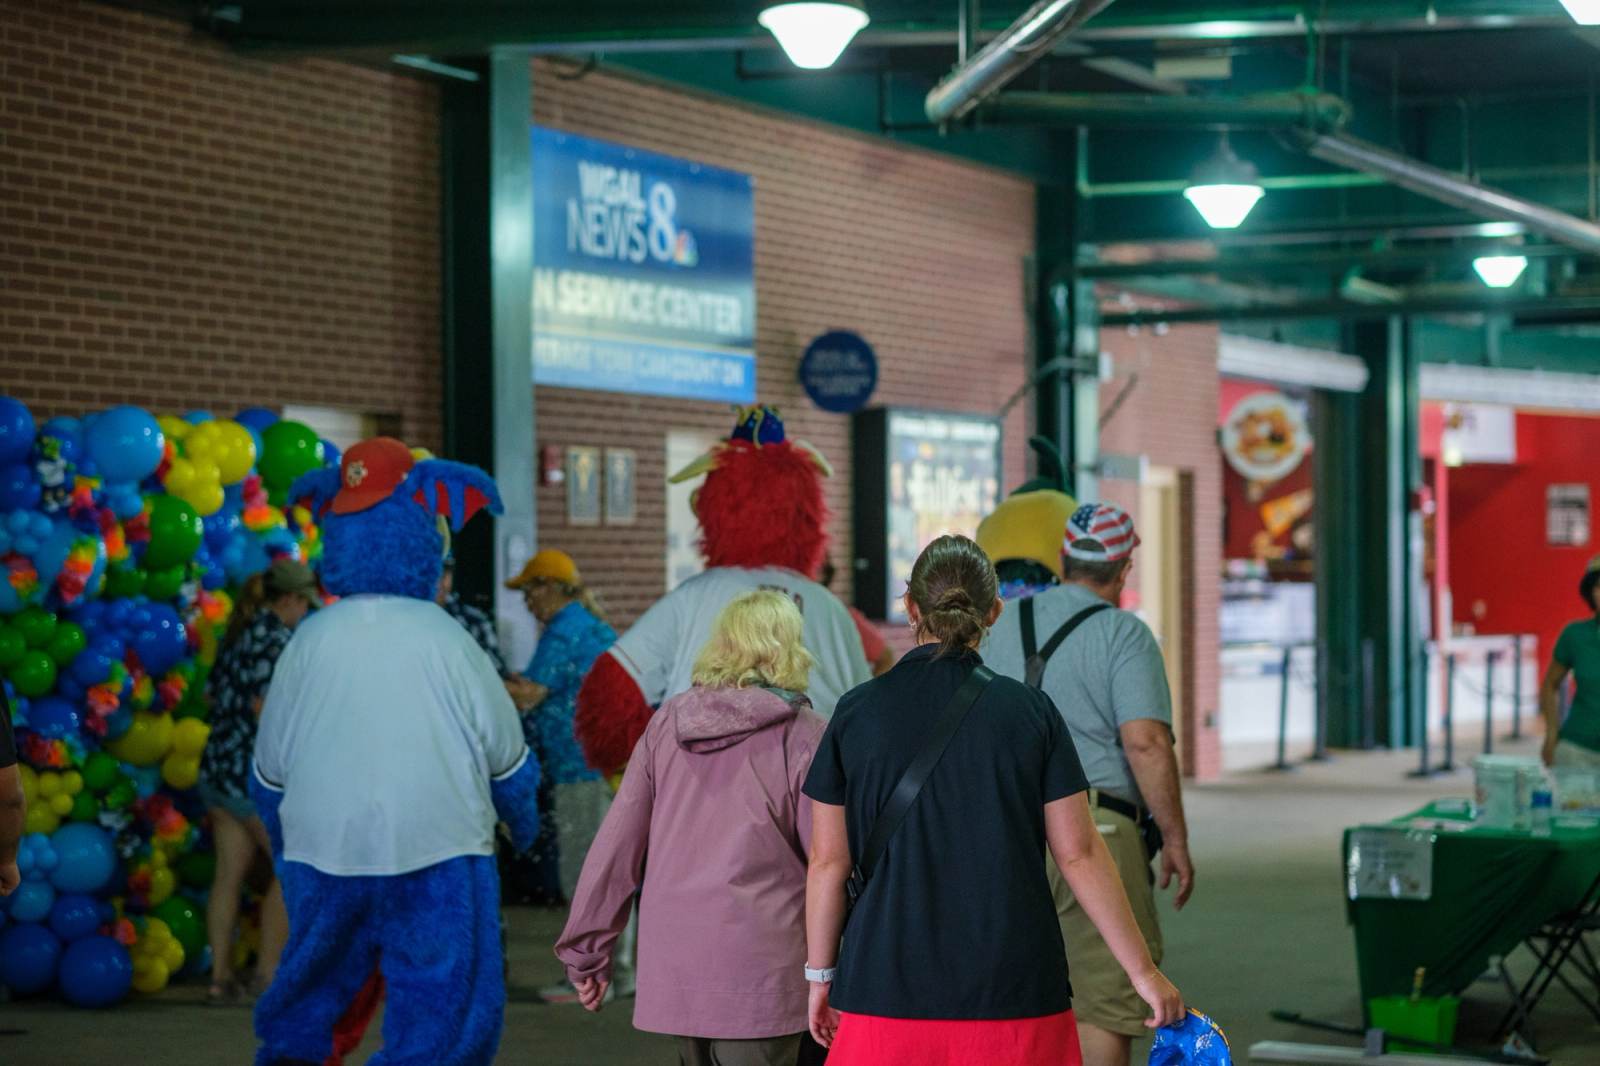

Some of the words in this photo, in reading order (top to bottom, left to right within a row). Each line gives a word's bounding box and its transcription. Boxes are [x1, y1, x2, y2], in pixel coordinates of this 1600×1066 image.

[577, 160, 645, 209] WGAL
[566, 198, 647, 263] NEWS
[649, 181, 677, 262] 8
[557, 269, 656, 325] SERVICE
[656, 284, 743, 337] CENTER
